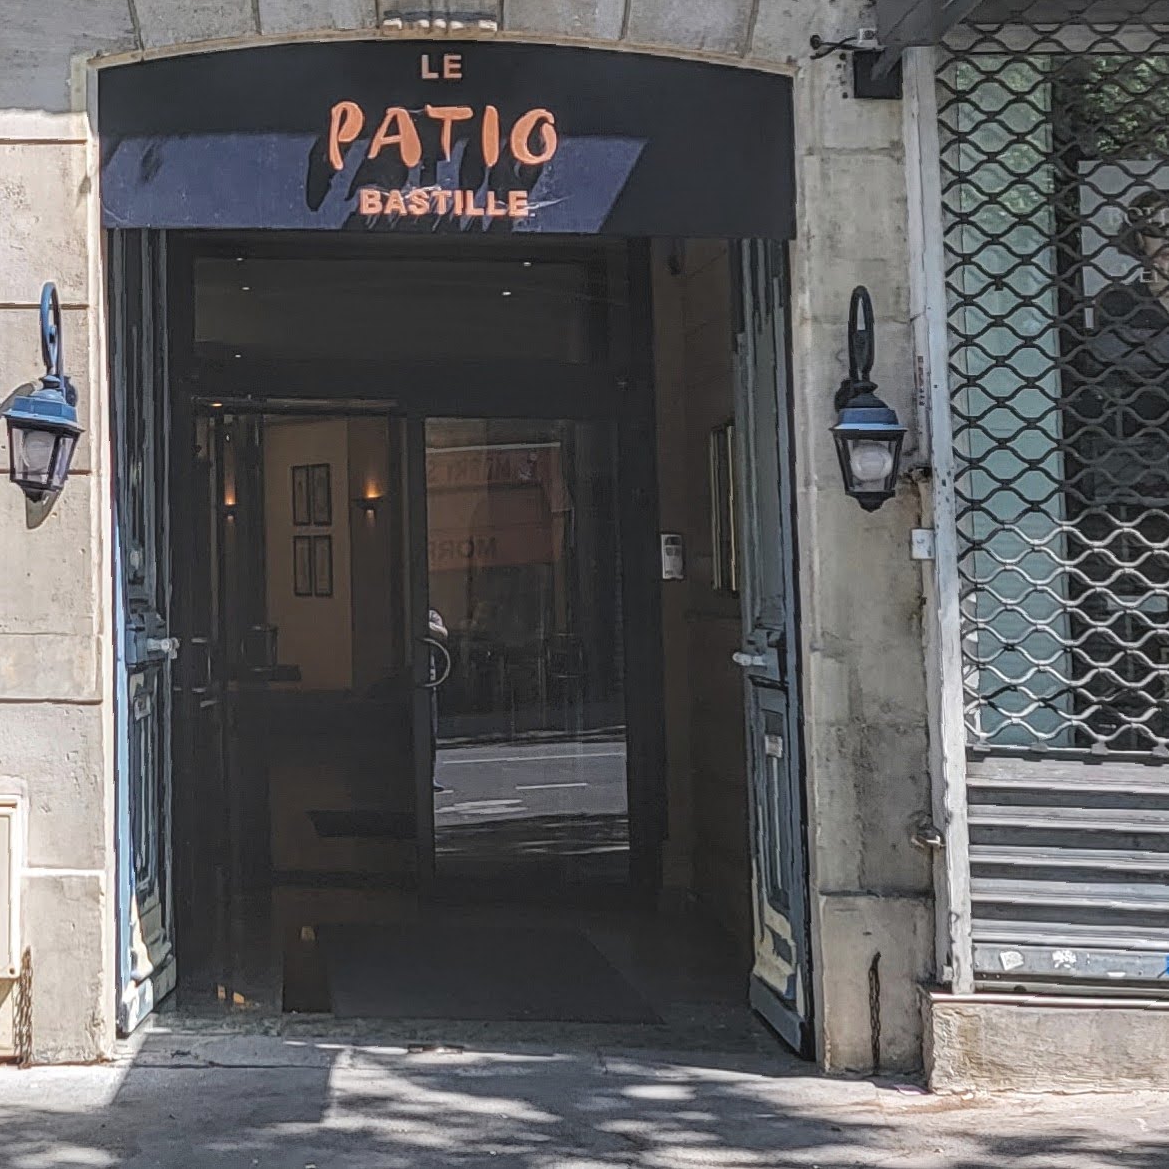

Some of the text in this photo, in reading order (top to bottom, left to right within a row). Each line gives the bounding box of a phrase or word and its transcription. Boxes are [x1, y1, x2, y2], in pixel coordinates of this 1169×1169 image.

[421, 54, 462, 79] LE
[329, 100, 557, 171] PATIO
[360, 189, 529, 217] BASTILLE
